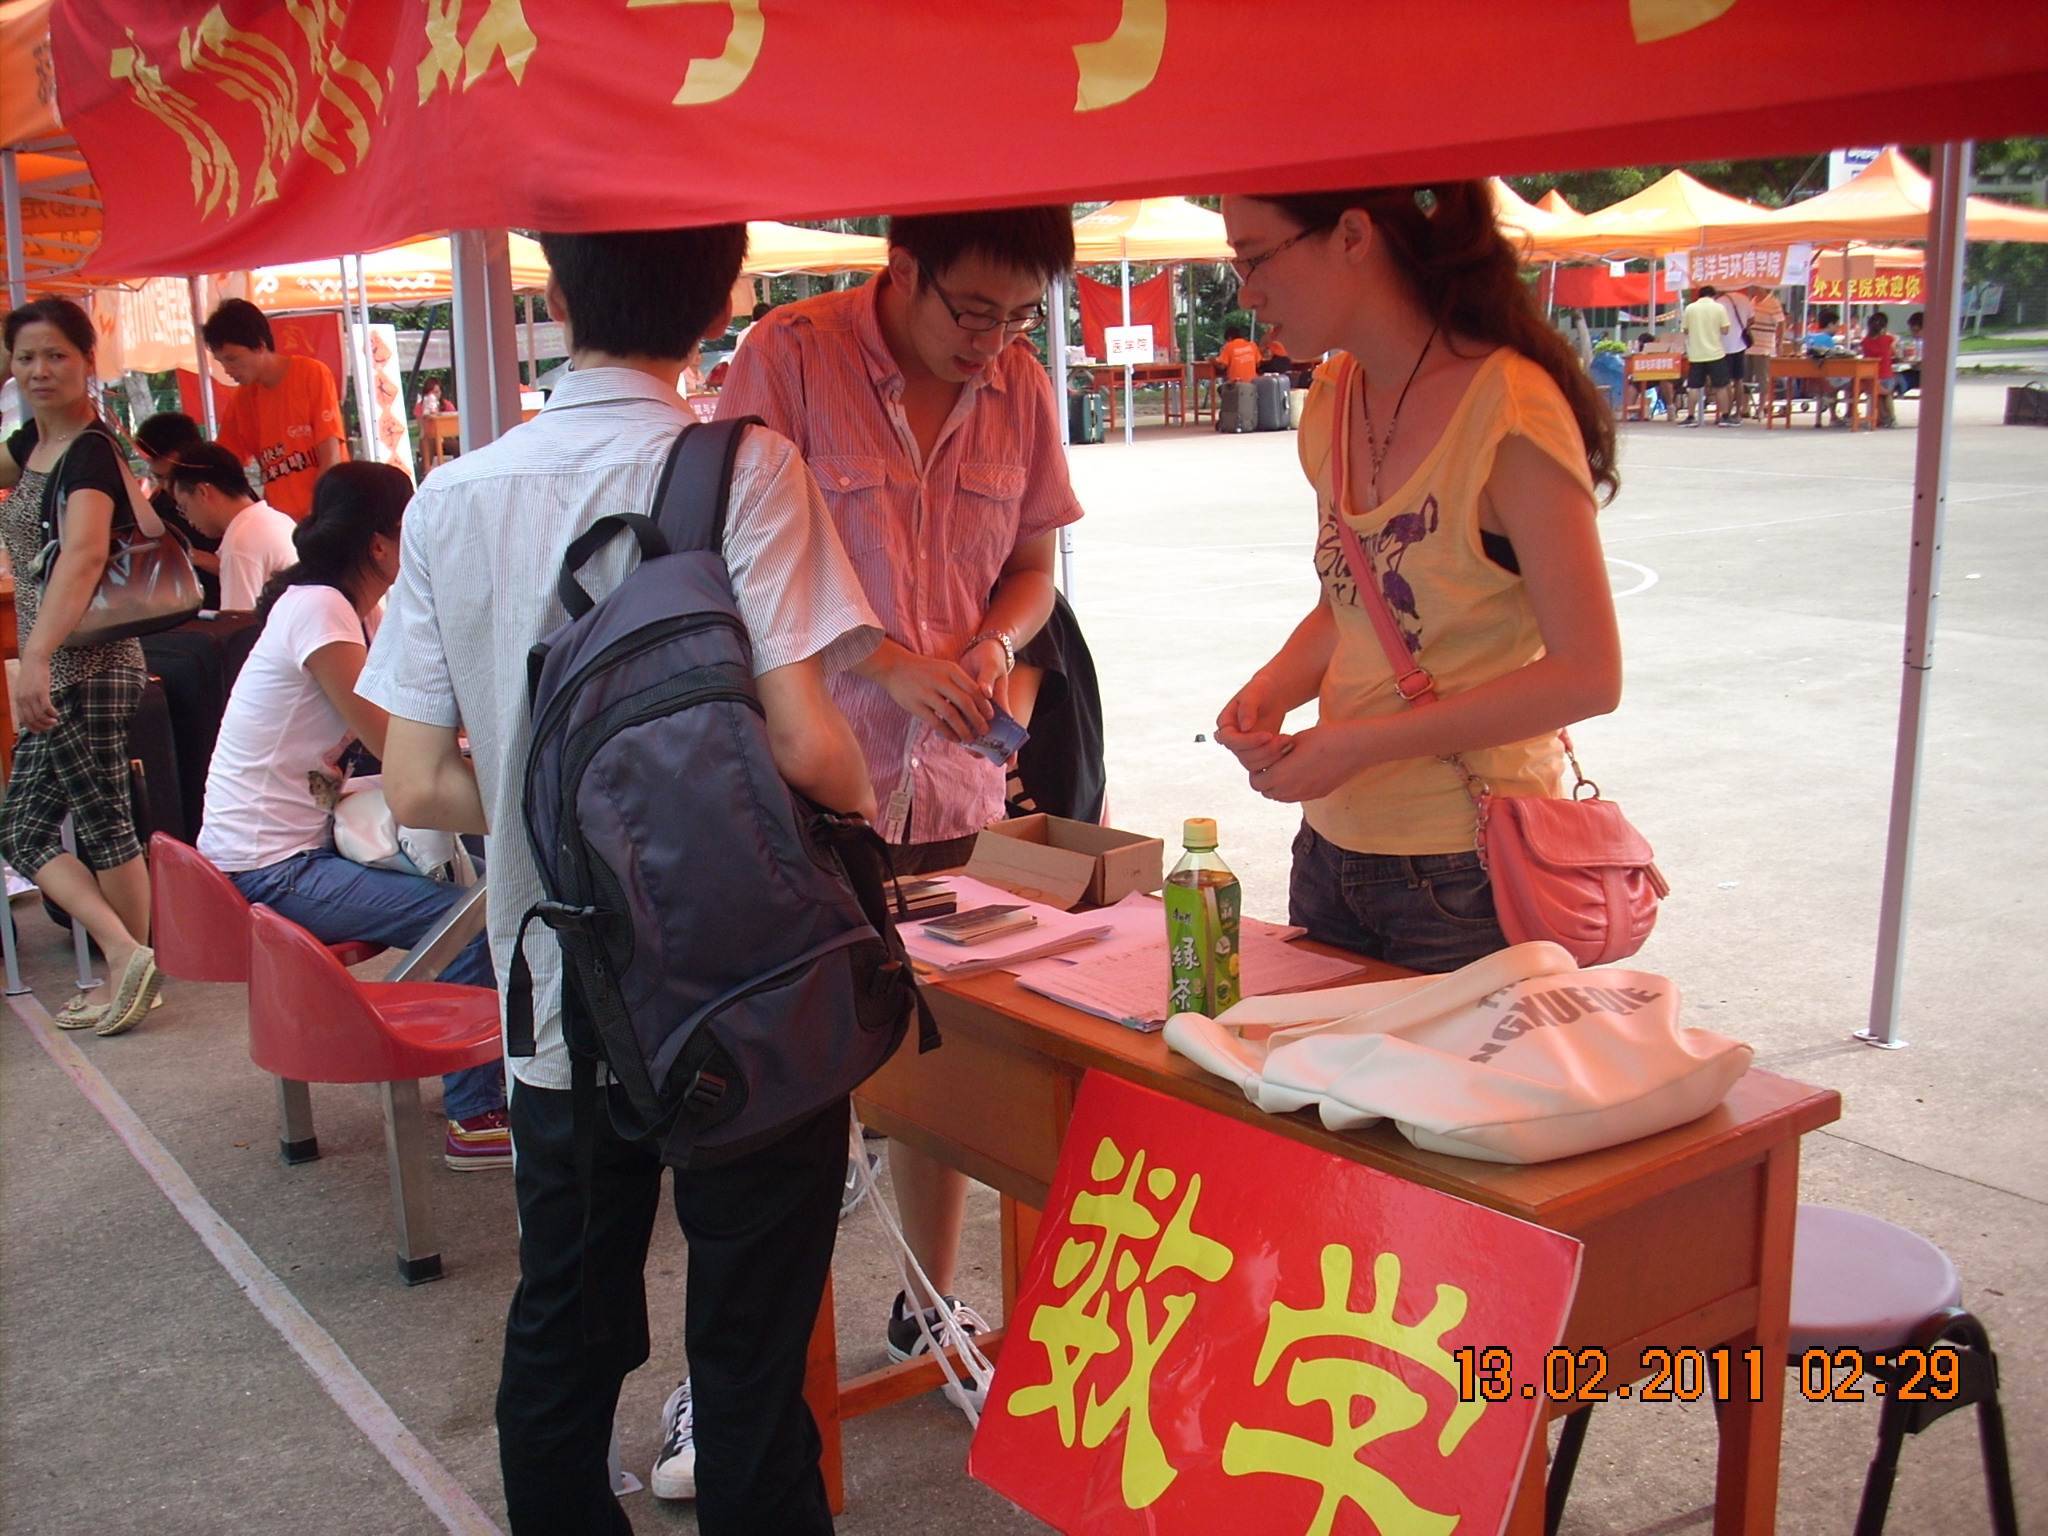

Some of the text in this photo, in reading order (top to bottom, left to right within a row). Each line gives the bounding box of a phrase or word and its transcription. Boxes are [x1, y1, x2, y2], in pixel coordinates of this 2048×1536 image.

[1691, 250, 1782, 281] 海洋与环境学院
[1007, 1136, 1487, 1536] 数学
